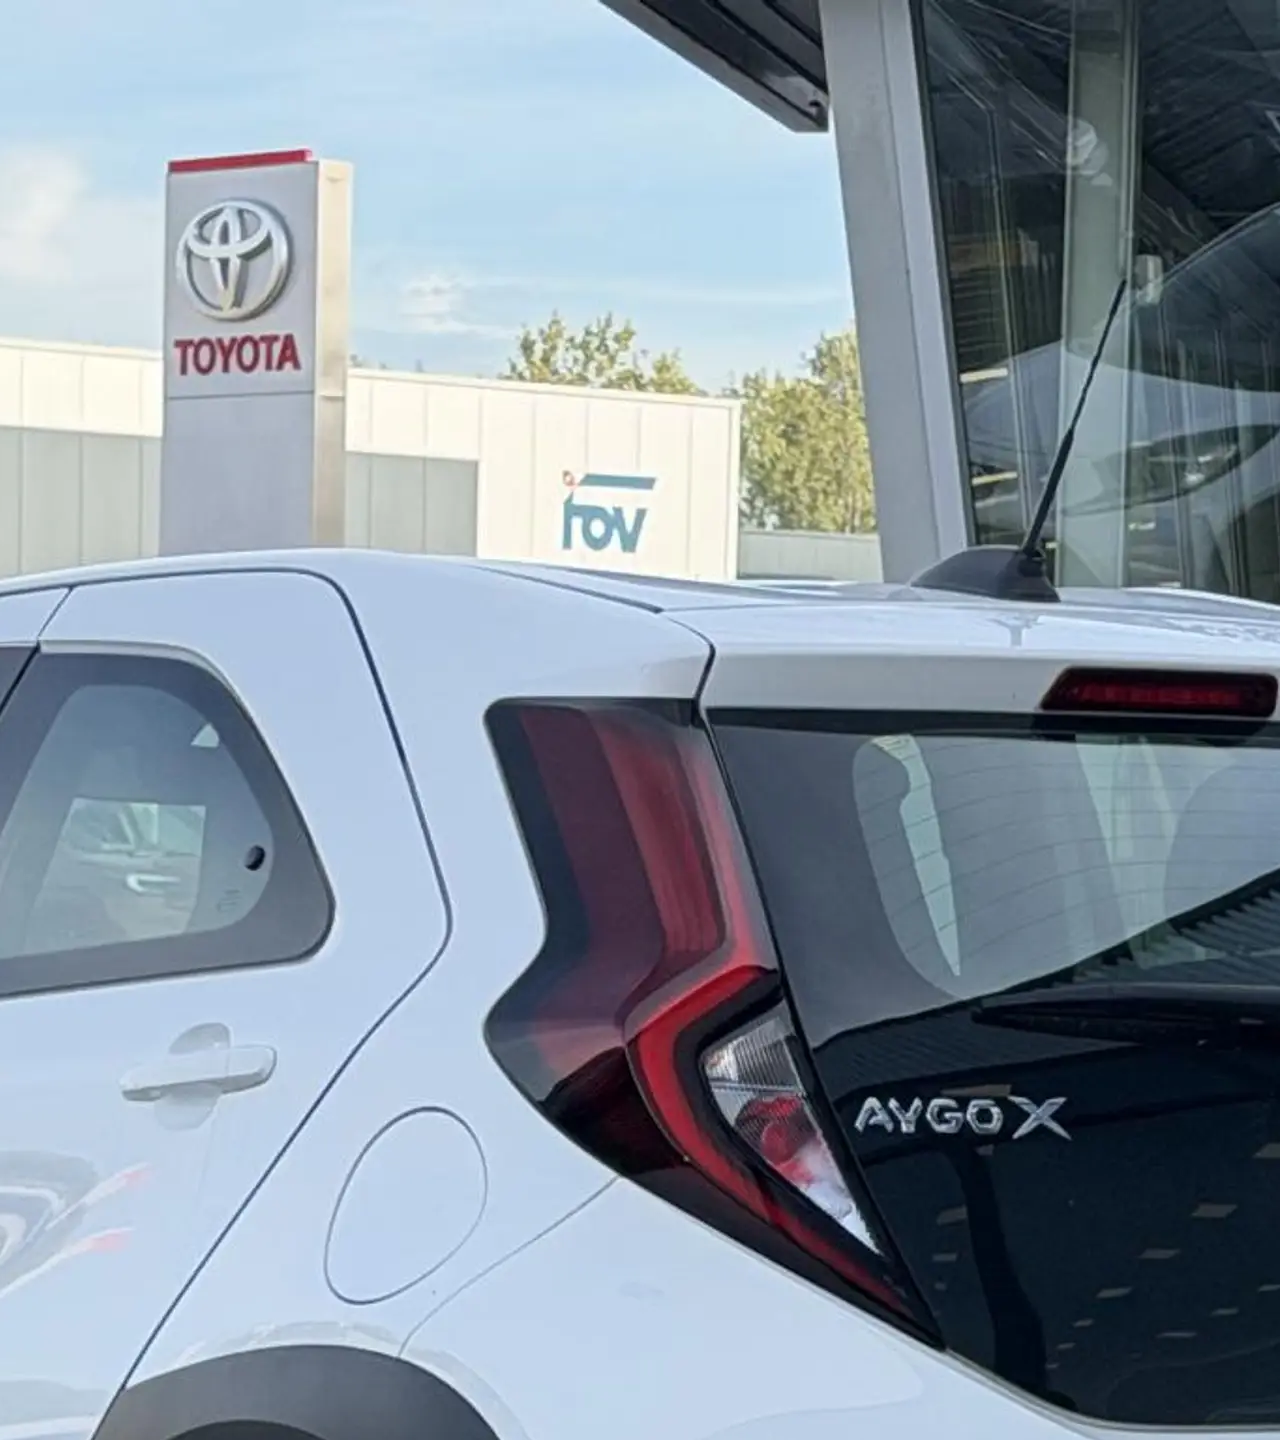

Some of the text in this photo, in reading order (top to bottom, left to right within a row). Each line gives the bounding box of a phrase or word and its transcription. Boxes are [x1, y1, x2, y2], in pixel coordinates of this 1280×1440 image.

[173, 332, 302, 376] TOYOTA
[854, 1094, 1072, 1141] AYGO X
